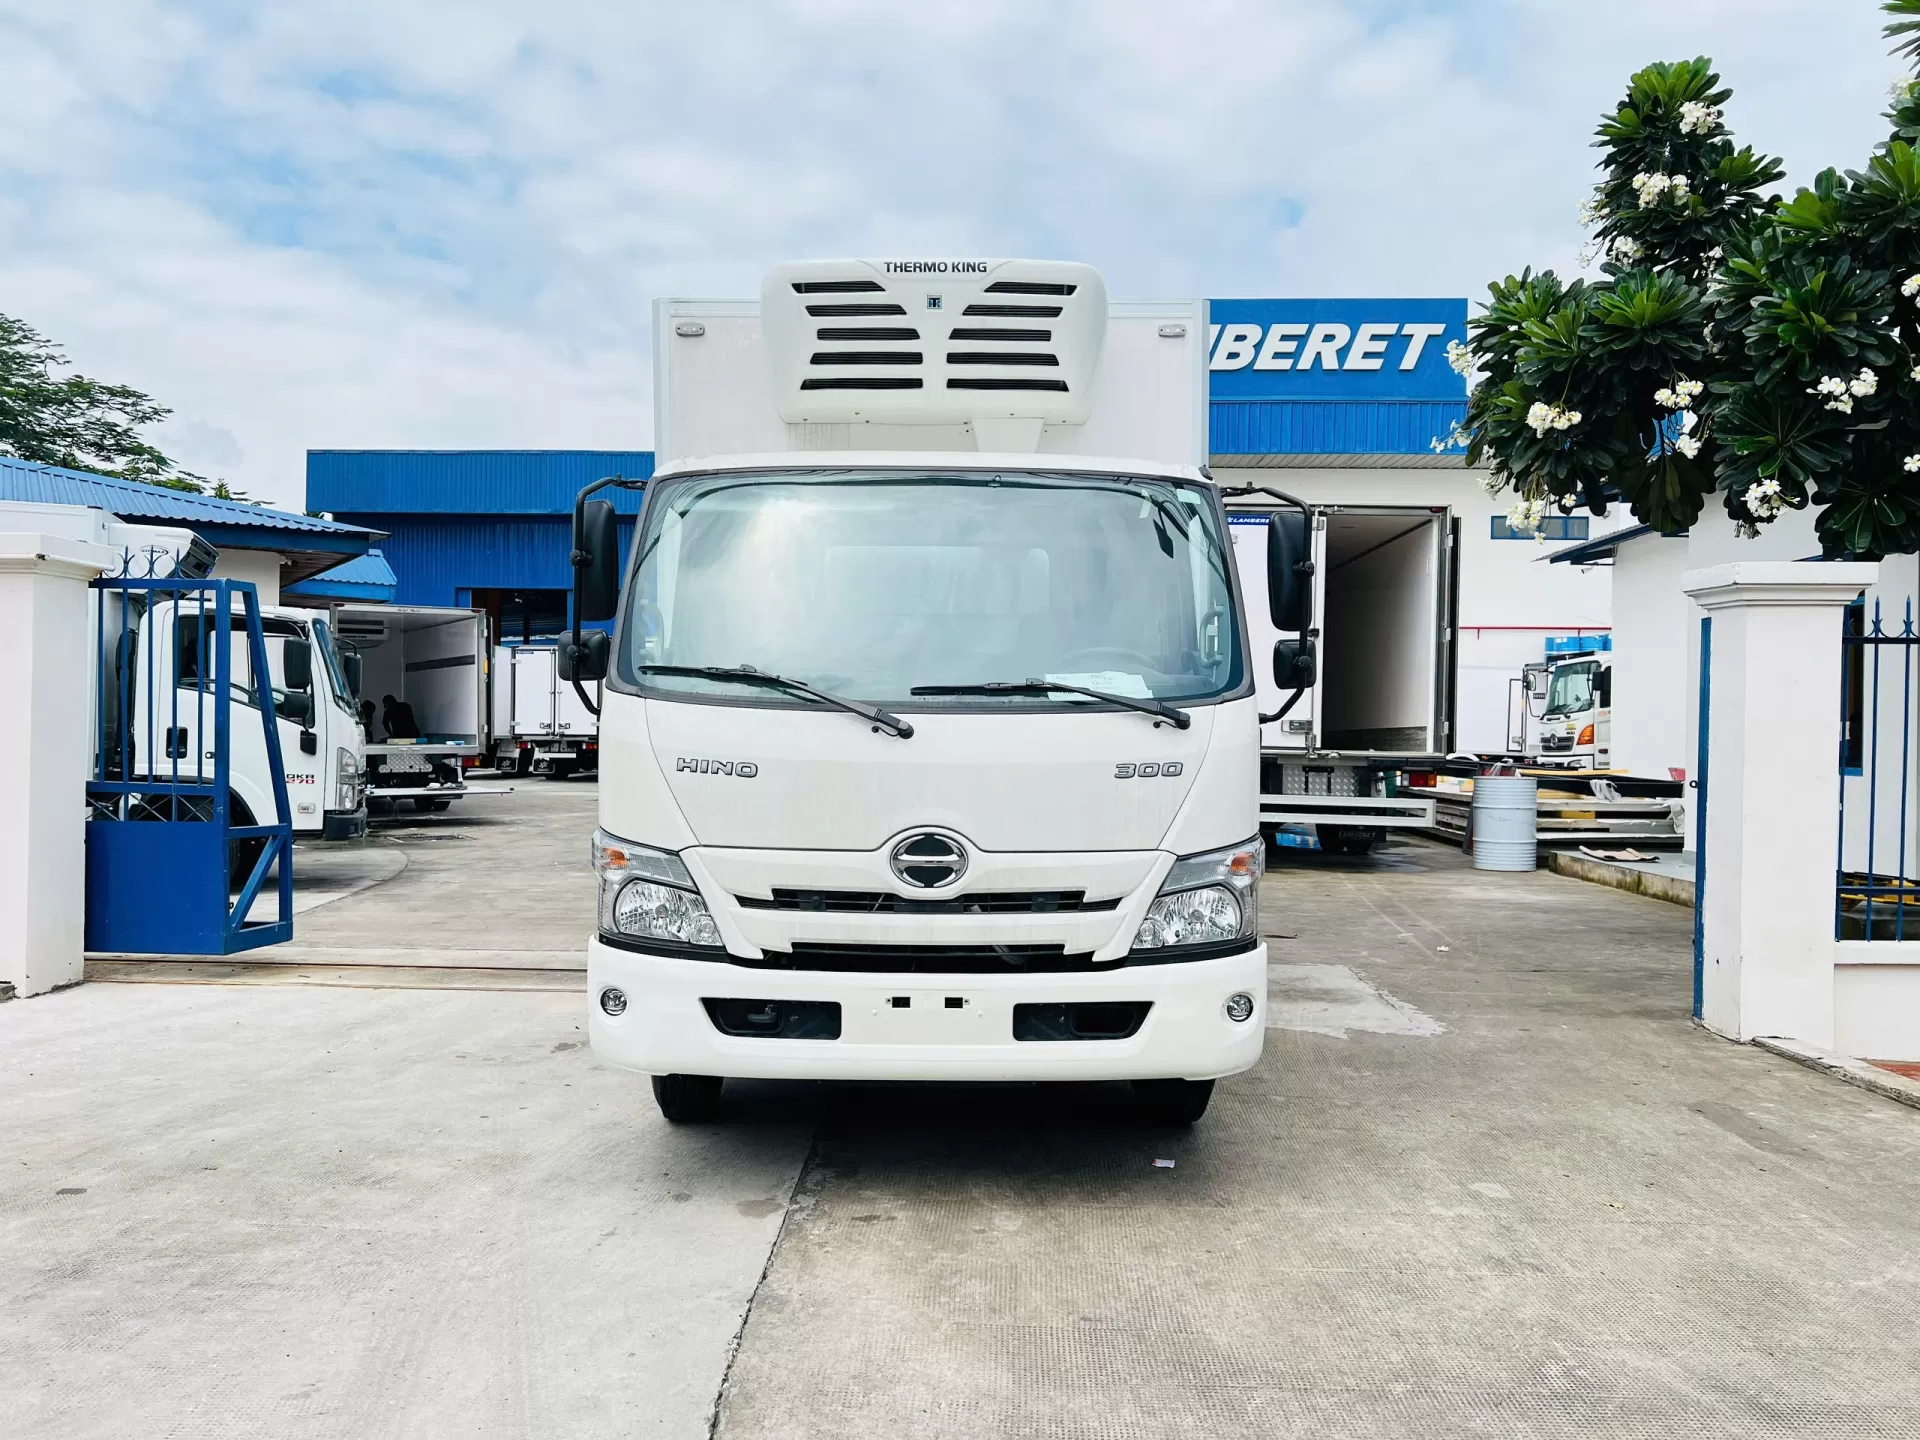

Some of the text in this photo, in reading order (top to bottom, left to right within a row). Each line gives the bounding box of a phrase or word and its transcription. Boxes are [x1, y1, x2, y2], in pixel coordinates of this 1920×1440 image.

[884, 262, 988, 273] THERMO KING
[676, 757, 759, 779] HINO
[1114, 761, 1184, 779] 300
